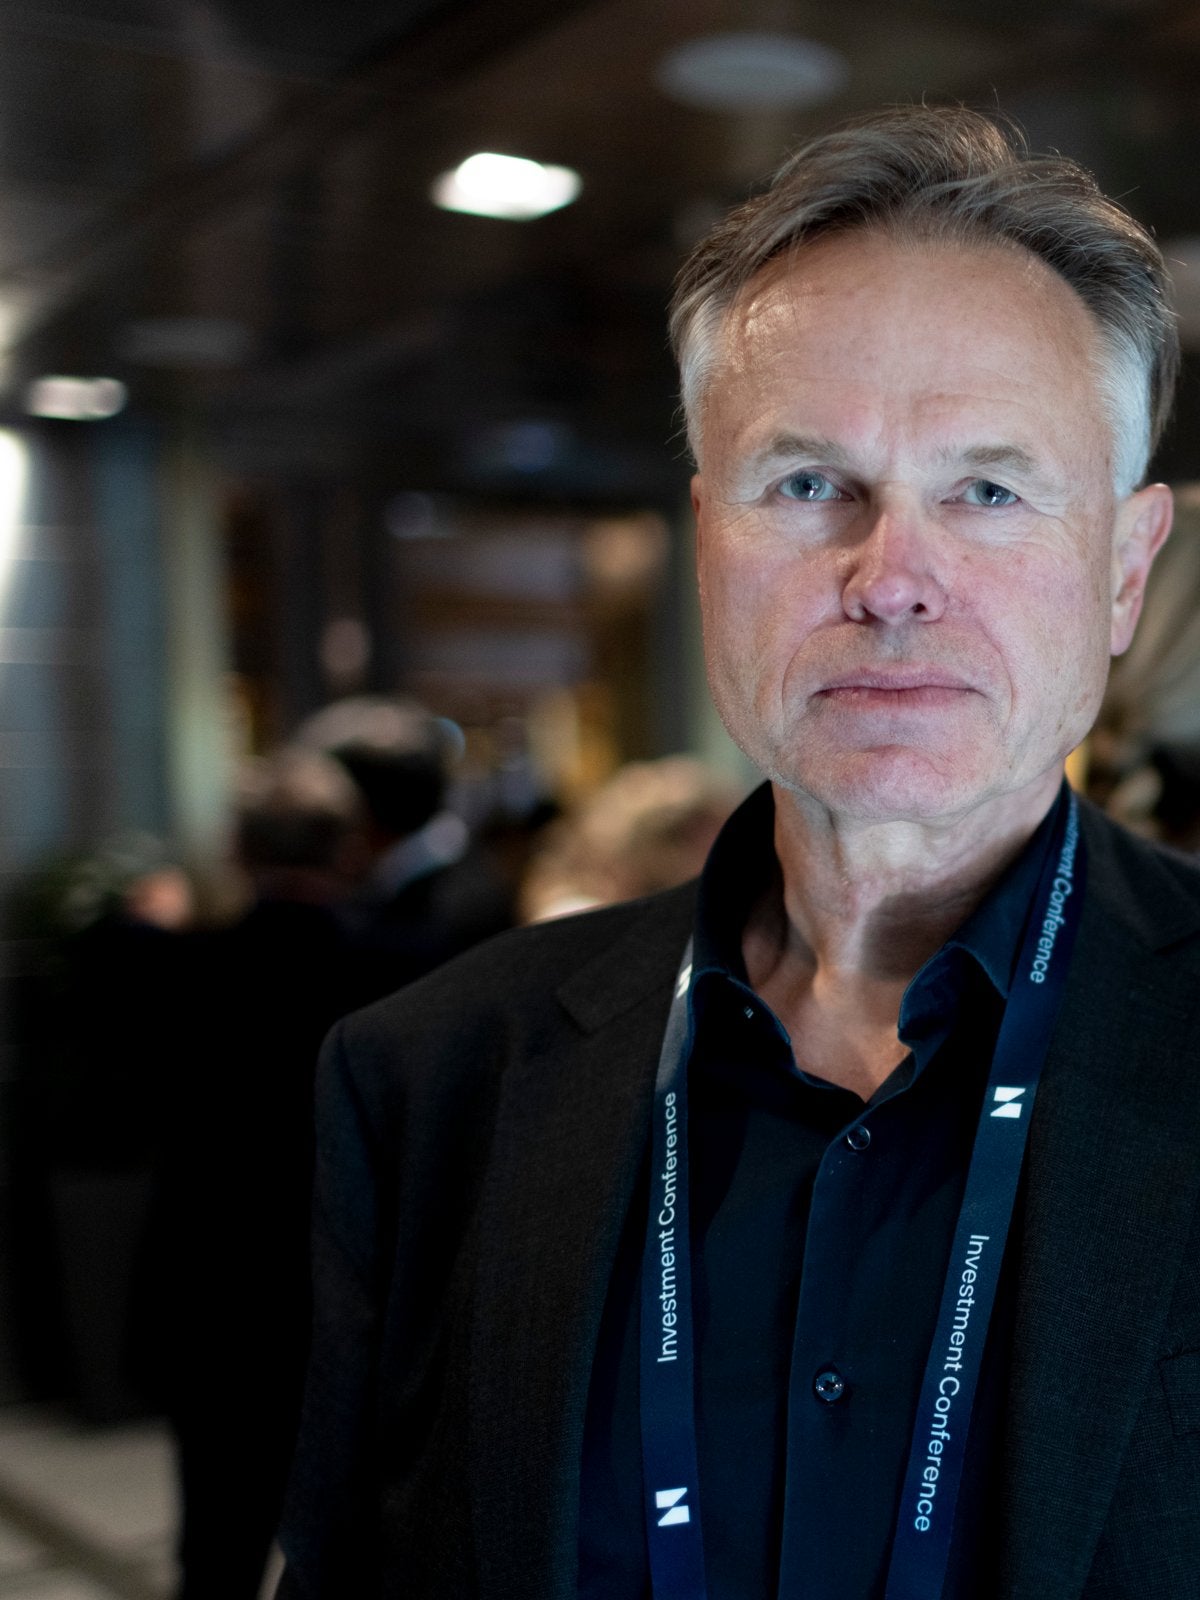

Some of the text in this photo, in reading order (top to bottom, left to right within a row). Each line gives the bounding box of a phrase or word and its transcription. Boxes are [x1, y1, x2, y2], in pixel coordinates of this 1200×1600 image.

[1030, 876, 1073, 984] Conference
[656, 1091, 678, 1363] Investment Conference
[914, 1234, 991, 1532] Investment Conference
